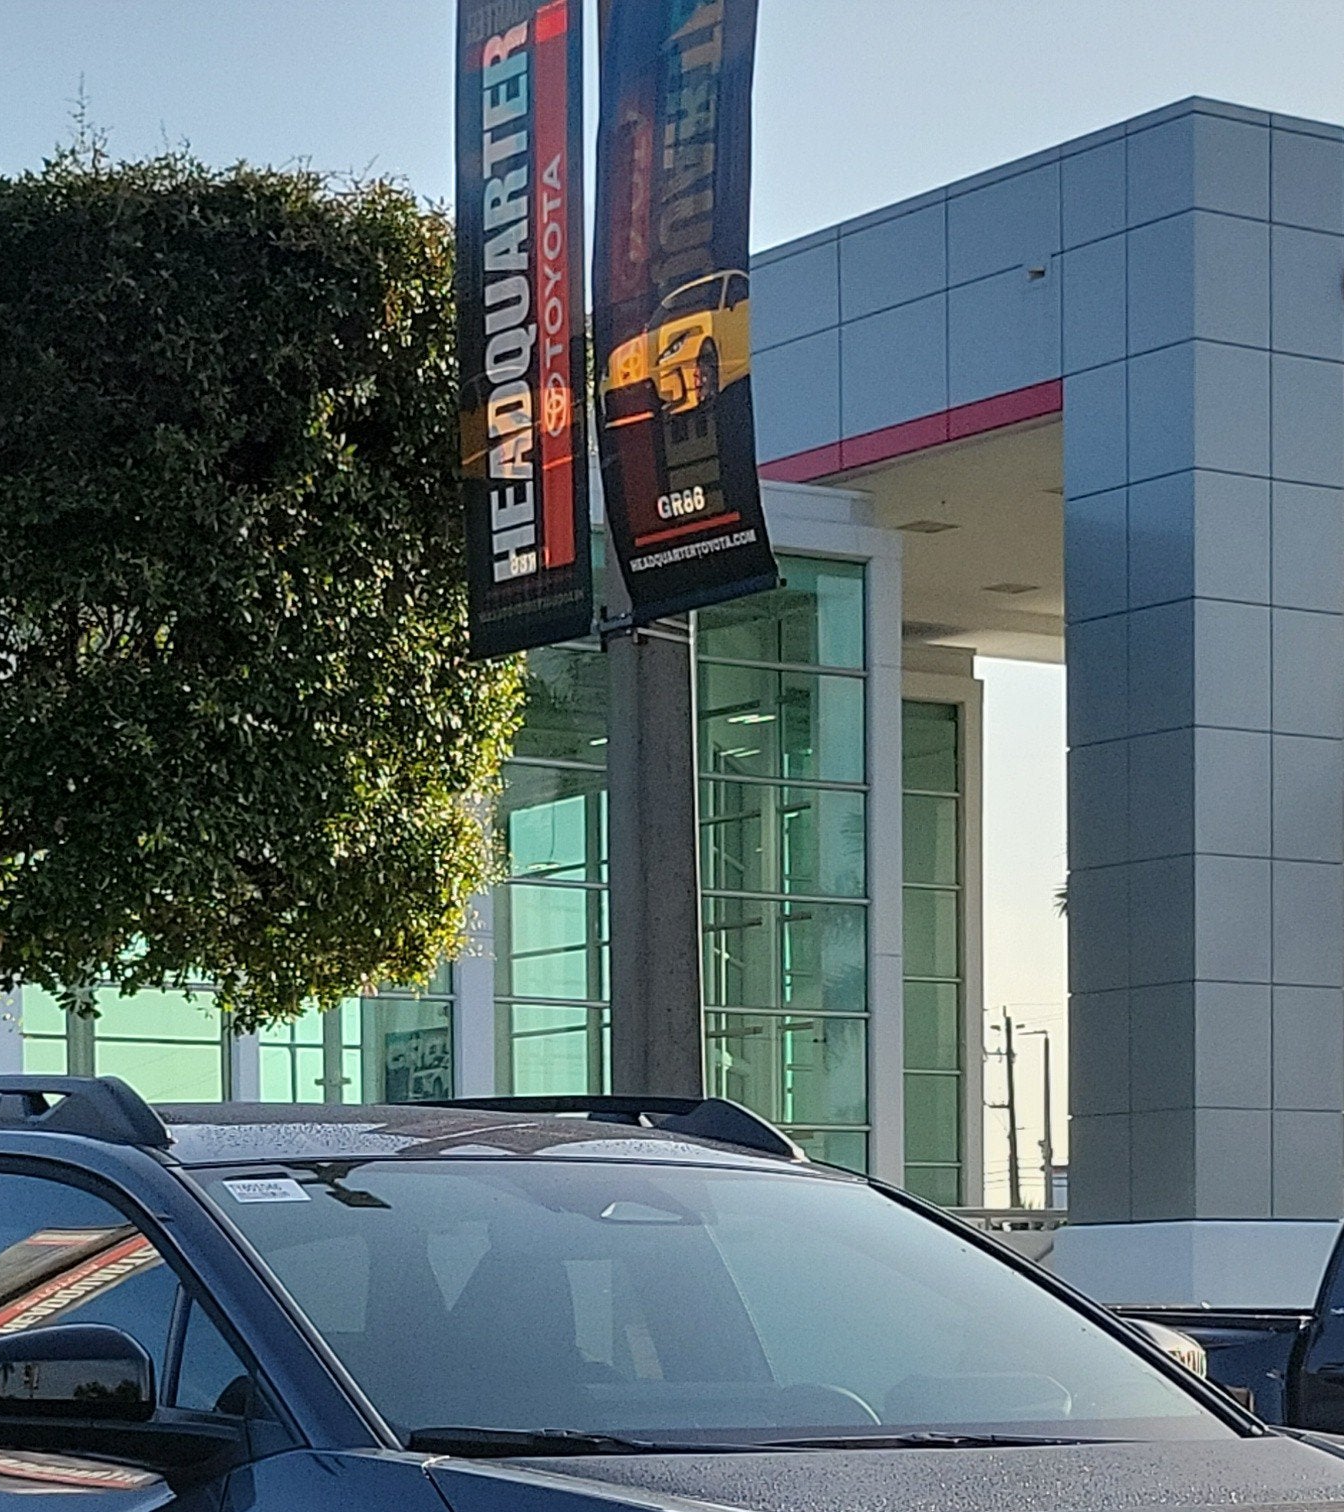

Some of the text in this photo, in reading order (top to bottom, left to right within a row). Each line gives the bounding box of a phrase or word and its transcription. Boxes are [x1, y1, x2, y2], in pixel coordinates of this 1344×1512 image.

[482, 20, 537, 583] HEADQUARTER
[543, 153, 564, 370] TOYOTA
[657, 486, 706, 519] GR86
